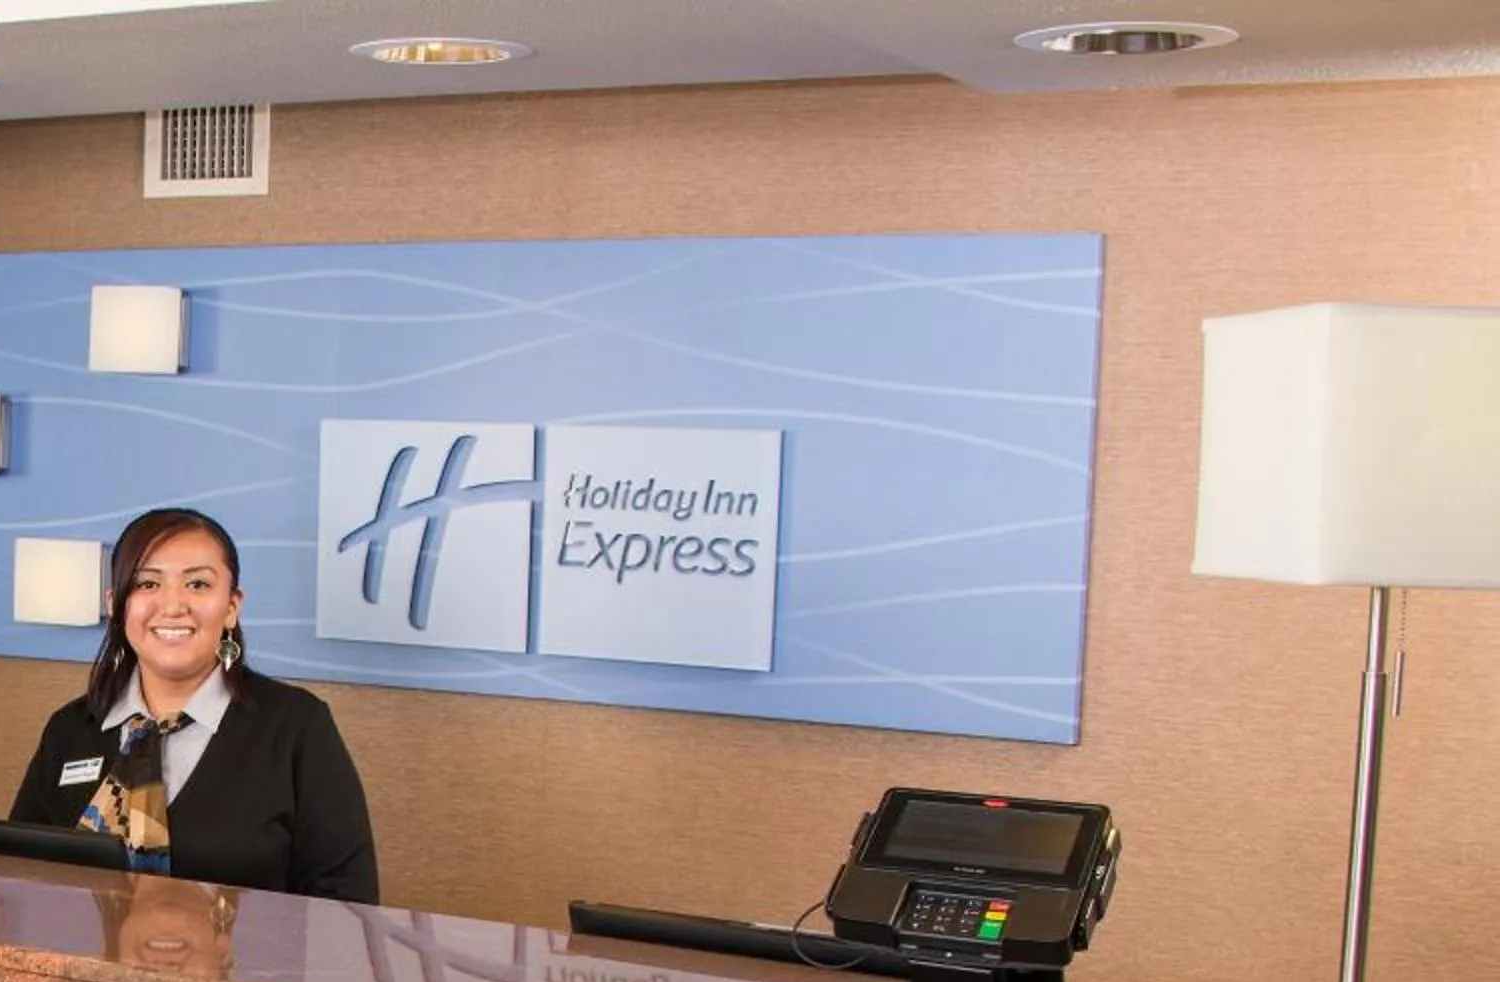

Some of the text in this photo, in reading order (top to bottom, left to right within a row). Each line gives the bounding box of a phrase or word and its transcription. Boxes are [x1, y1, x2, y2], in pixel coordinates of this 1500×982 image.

[563, 472, 759, 521] Holiday Inn
[557, 519, 760, 585] Express
